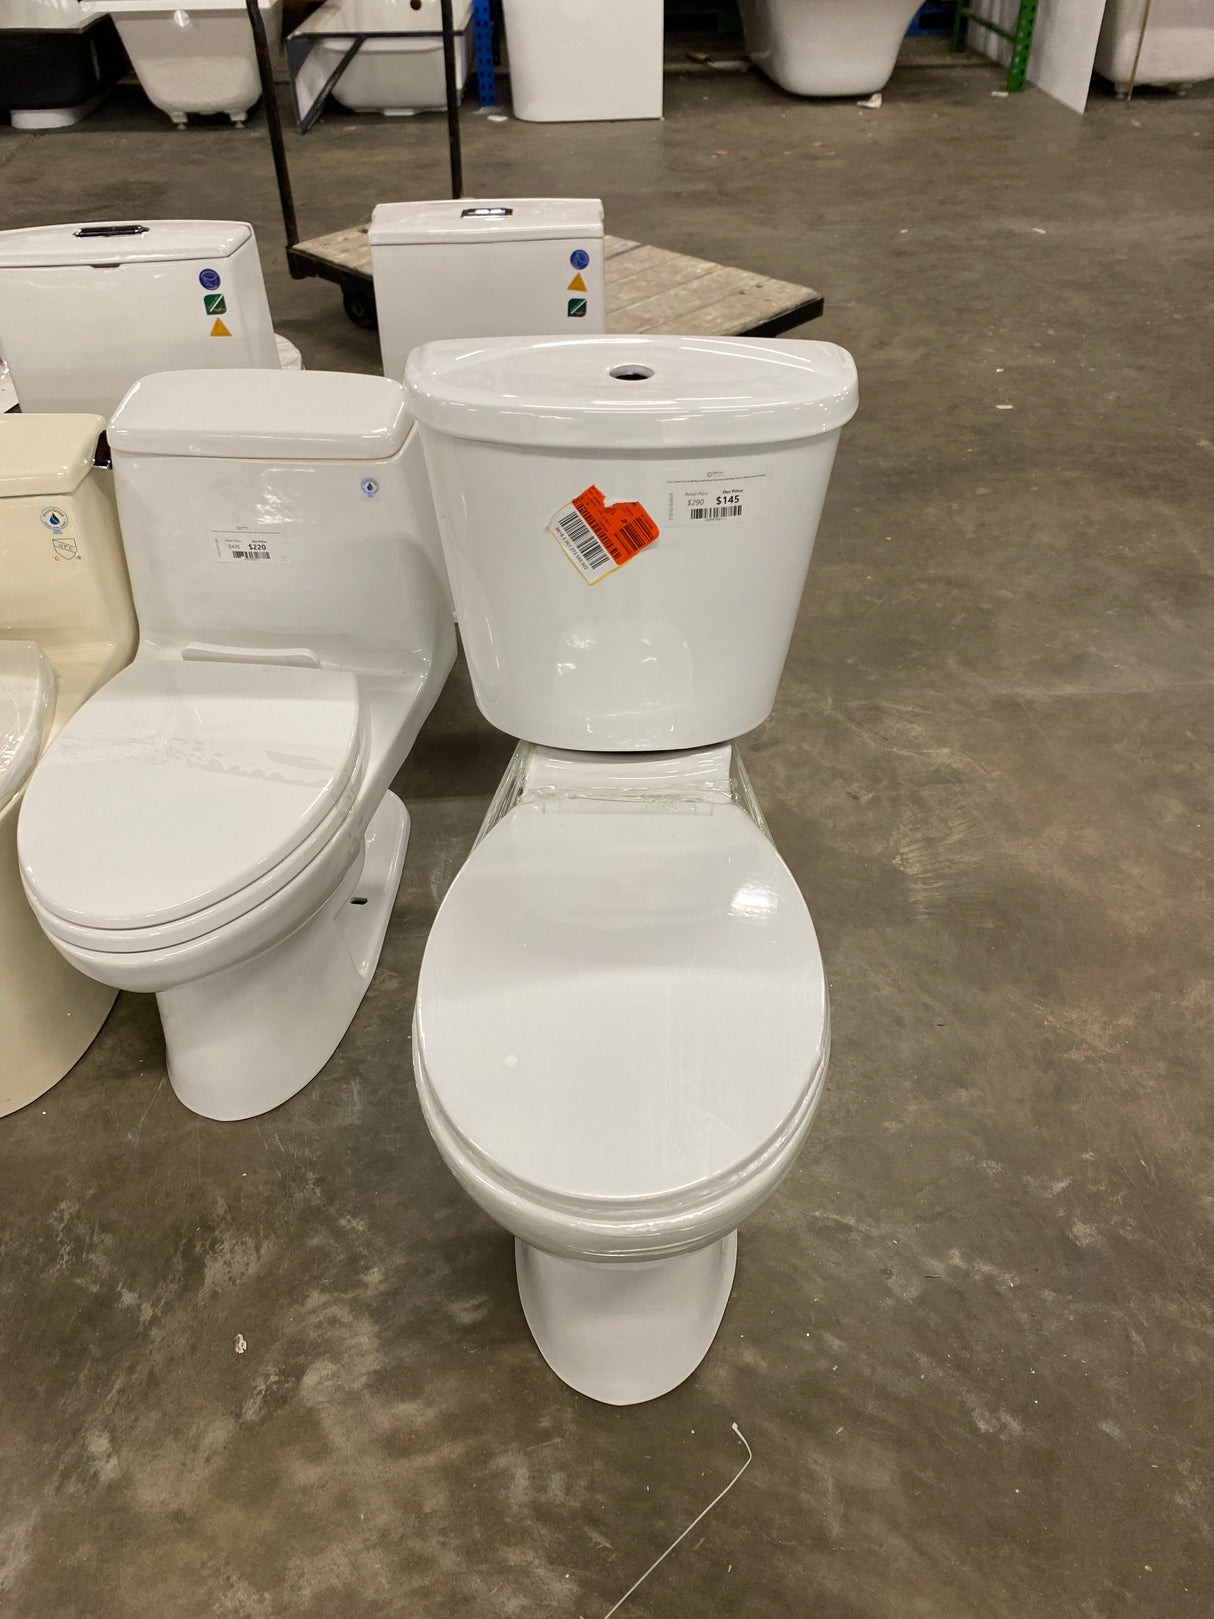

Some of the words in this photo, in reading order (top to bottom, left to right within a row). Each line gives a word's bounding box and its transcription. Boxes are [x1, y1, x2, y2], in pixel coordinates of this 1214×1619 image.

[687, 498, 705, 506] $290
[716, 494, 740, 505] $145
[248, 543, 267, 551] $220
